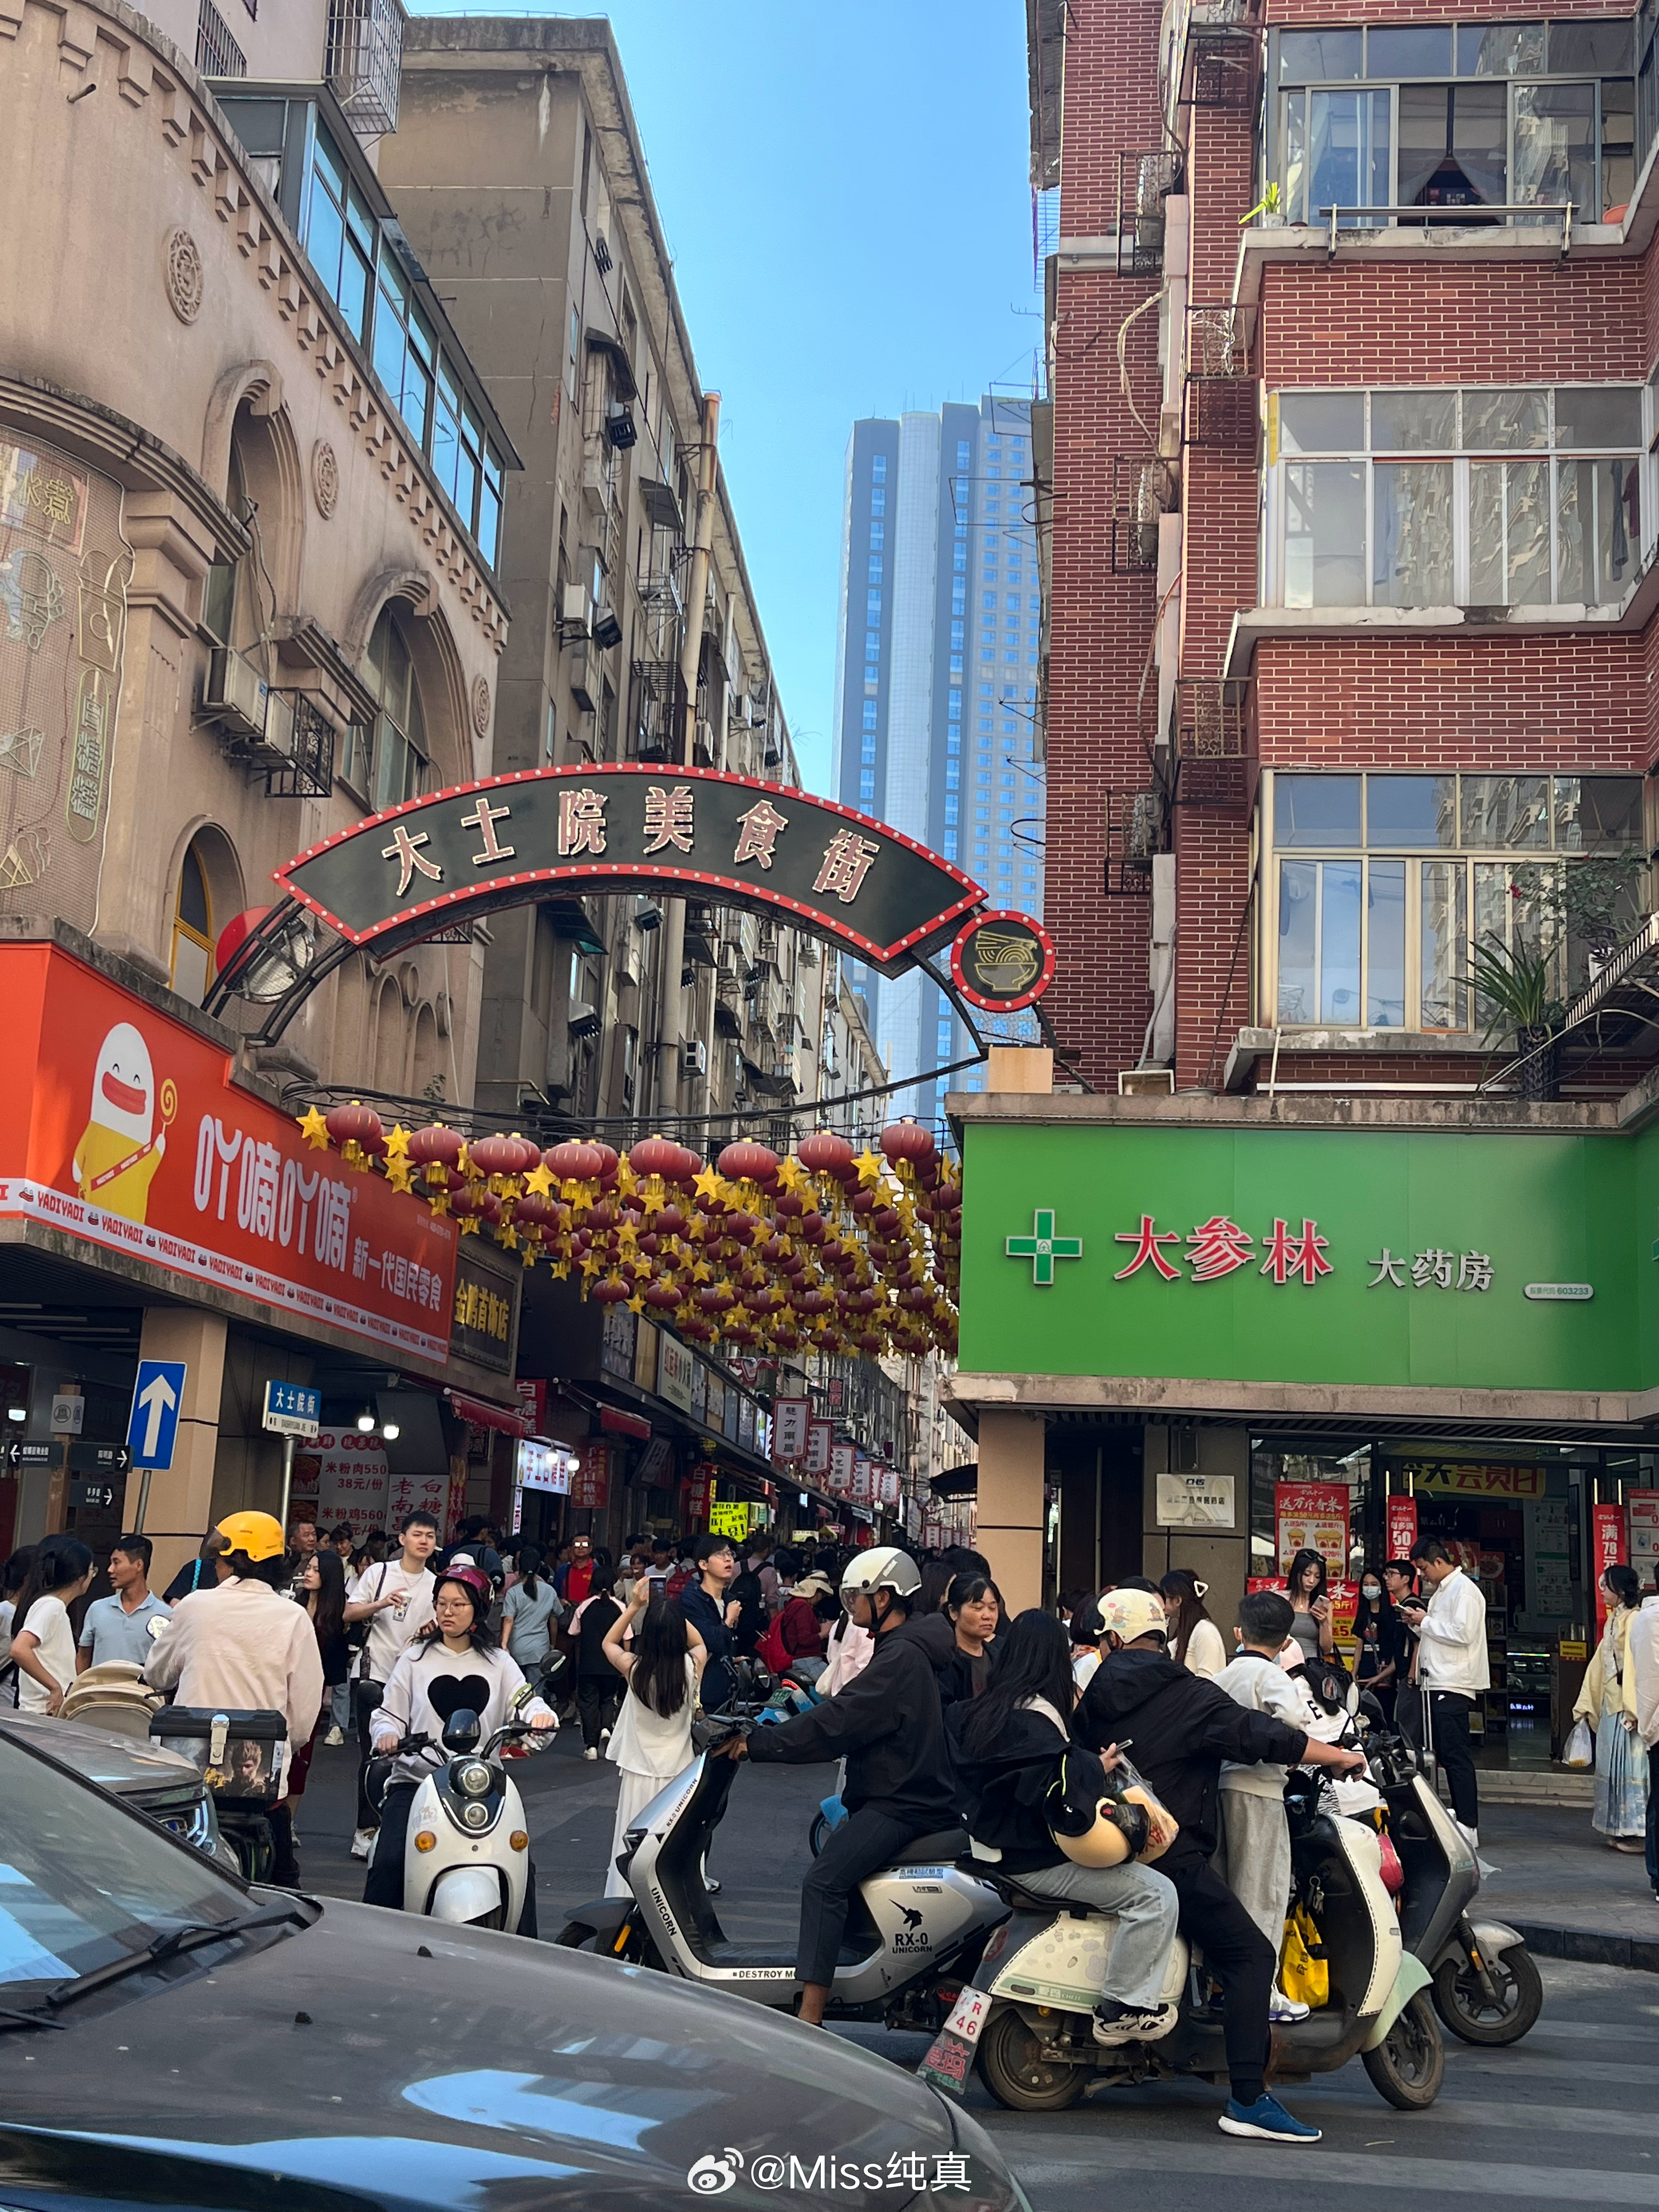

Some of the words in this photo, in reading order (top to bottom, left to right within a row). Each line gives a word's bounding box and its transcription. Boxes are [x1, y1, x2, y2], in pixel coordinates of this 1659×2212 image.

[71, 692, 104, 821] 白糖糕
[380, 785, 881, 904] 大士院美食街
[38, 1190, 84, 1223] YADIYADI
[102, 1215, 144, 1244] YADIYADI
[159, 1236, 196, 1263] YADIYADI
[1114, 1213, 1334, 1285] 大参林
[209, 1255, 243, 1280] YADIYADI
[353, 1236, 442, 1312] 新一代国民零食
[1367, 1248, 1495, 1292] 大药房
[255, 1273, 286, 1297] YADIYADI
[296, 1288, 324, 1311] YADIYADI
[275, 1387, 315, 1414] 大士院街
[337, 1478, 383, 1491] 38元/份
[418, 1479, 443, 1515] 白糖
[689, 1466, 707, 1515] 白糖糕
[321, 1507, 385, 1521] 米粉鸡560
[1279, 1496, 1344, 1513] 送万斤香米
[1392, 1531, 1412, 1547] 50
[1331, 1600, 1353, 1610] 5斤!
[675, 1778, 698, 1813] UNICORN
[651, 1887, 678, 1937] UNICORN
[892, 1945, 933, 1954] UNICORN
[894, 1932, 929, 1946] RX-0
[738, 1970, 783, 1978] DESTROY
